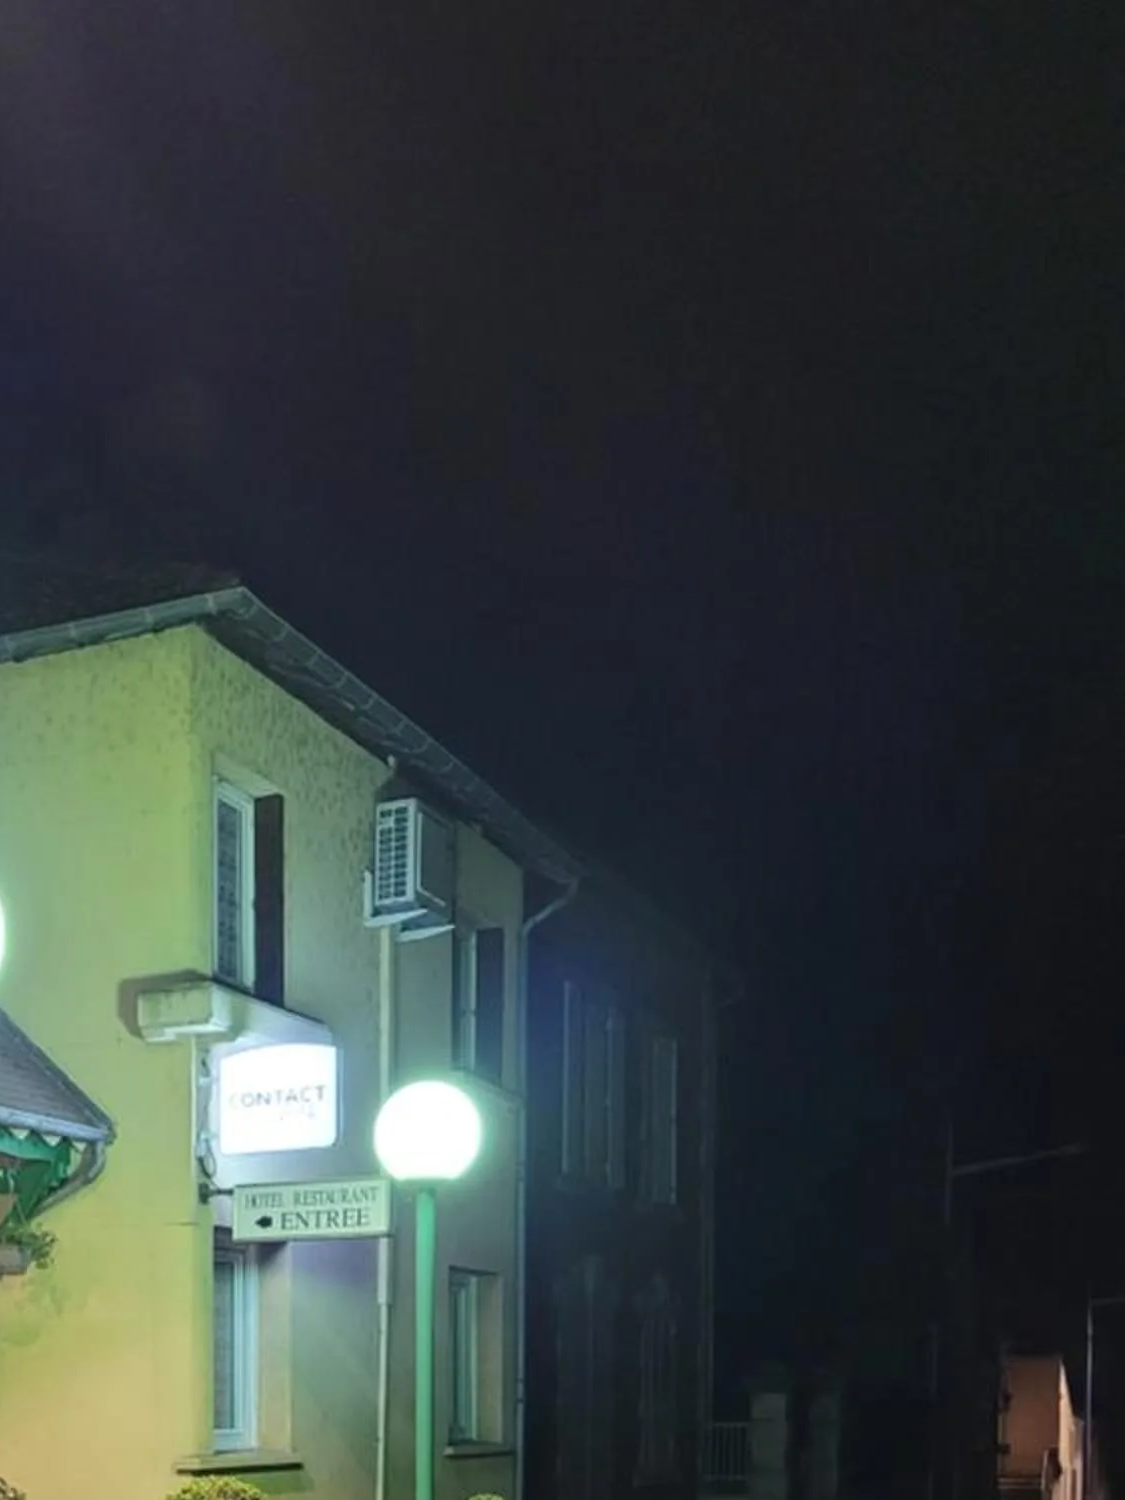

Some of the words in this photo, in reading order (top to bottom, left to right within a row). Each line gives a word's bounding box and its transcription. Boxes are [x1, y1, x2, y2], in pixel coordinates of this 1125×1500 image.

[228, 1084, 327, 1110] CONTACT
[245, 1191, 283, 1208] HOTEL
[293, 1186, 379, 1207] RESTAURANT
[281, 1208, 370, 1230] ENTREE
